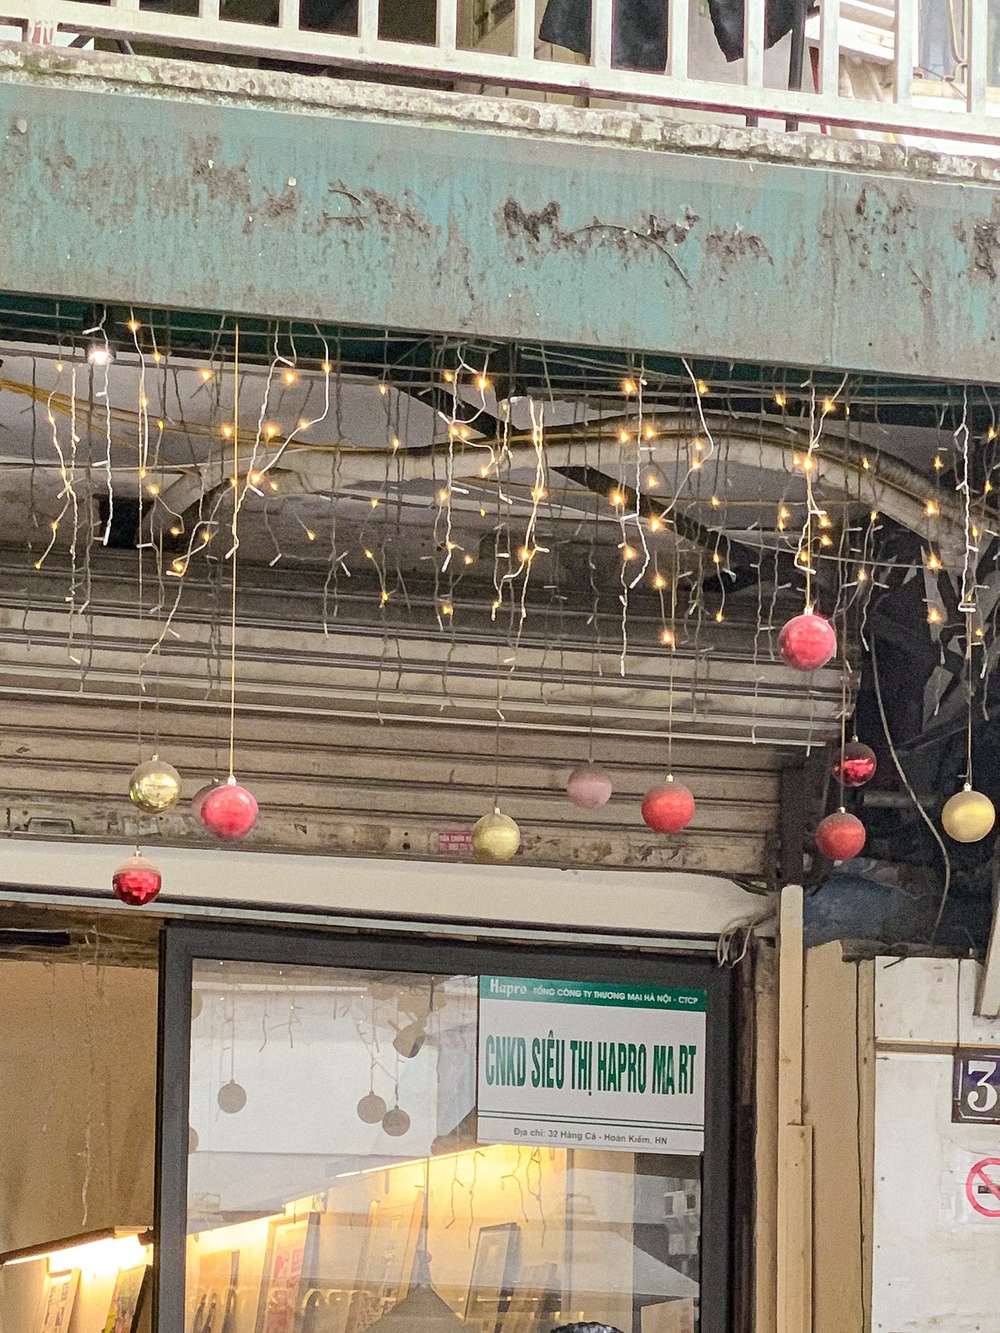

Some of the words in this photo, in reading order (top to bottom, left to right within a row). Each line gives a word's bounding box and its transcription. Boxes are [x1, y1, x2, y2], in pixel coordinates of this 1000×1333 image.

[489, 978, 528, 998] Hapro
[583, 990, 593, 998] TY
[485, 1034, 527, 1087] CNKD
[531, 1029, 566, 1090] SIÊU
[569, 1039, 593, 1096] THỊ
[597, 1041, 647, 1094] HAPRO
[548, 1129, 558, 1138] 32
[560, 1130, 583, 1142] Hàng
[655, 1136, 668, 1145] HN
